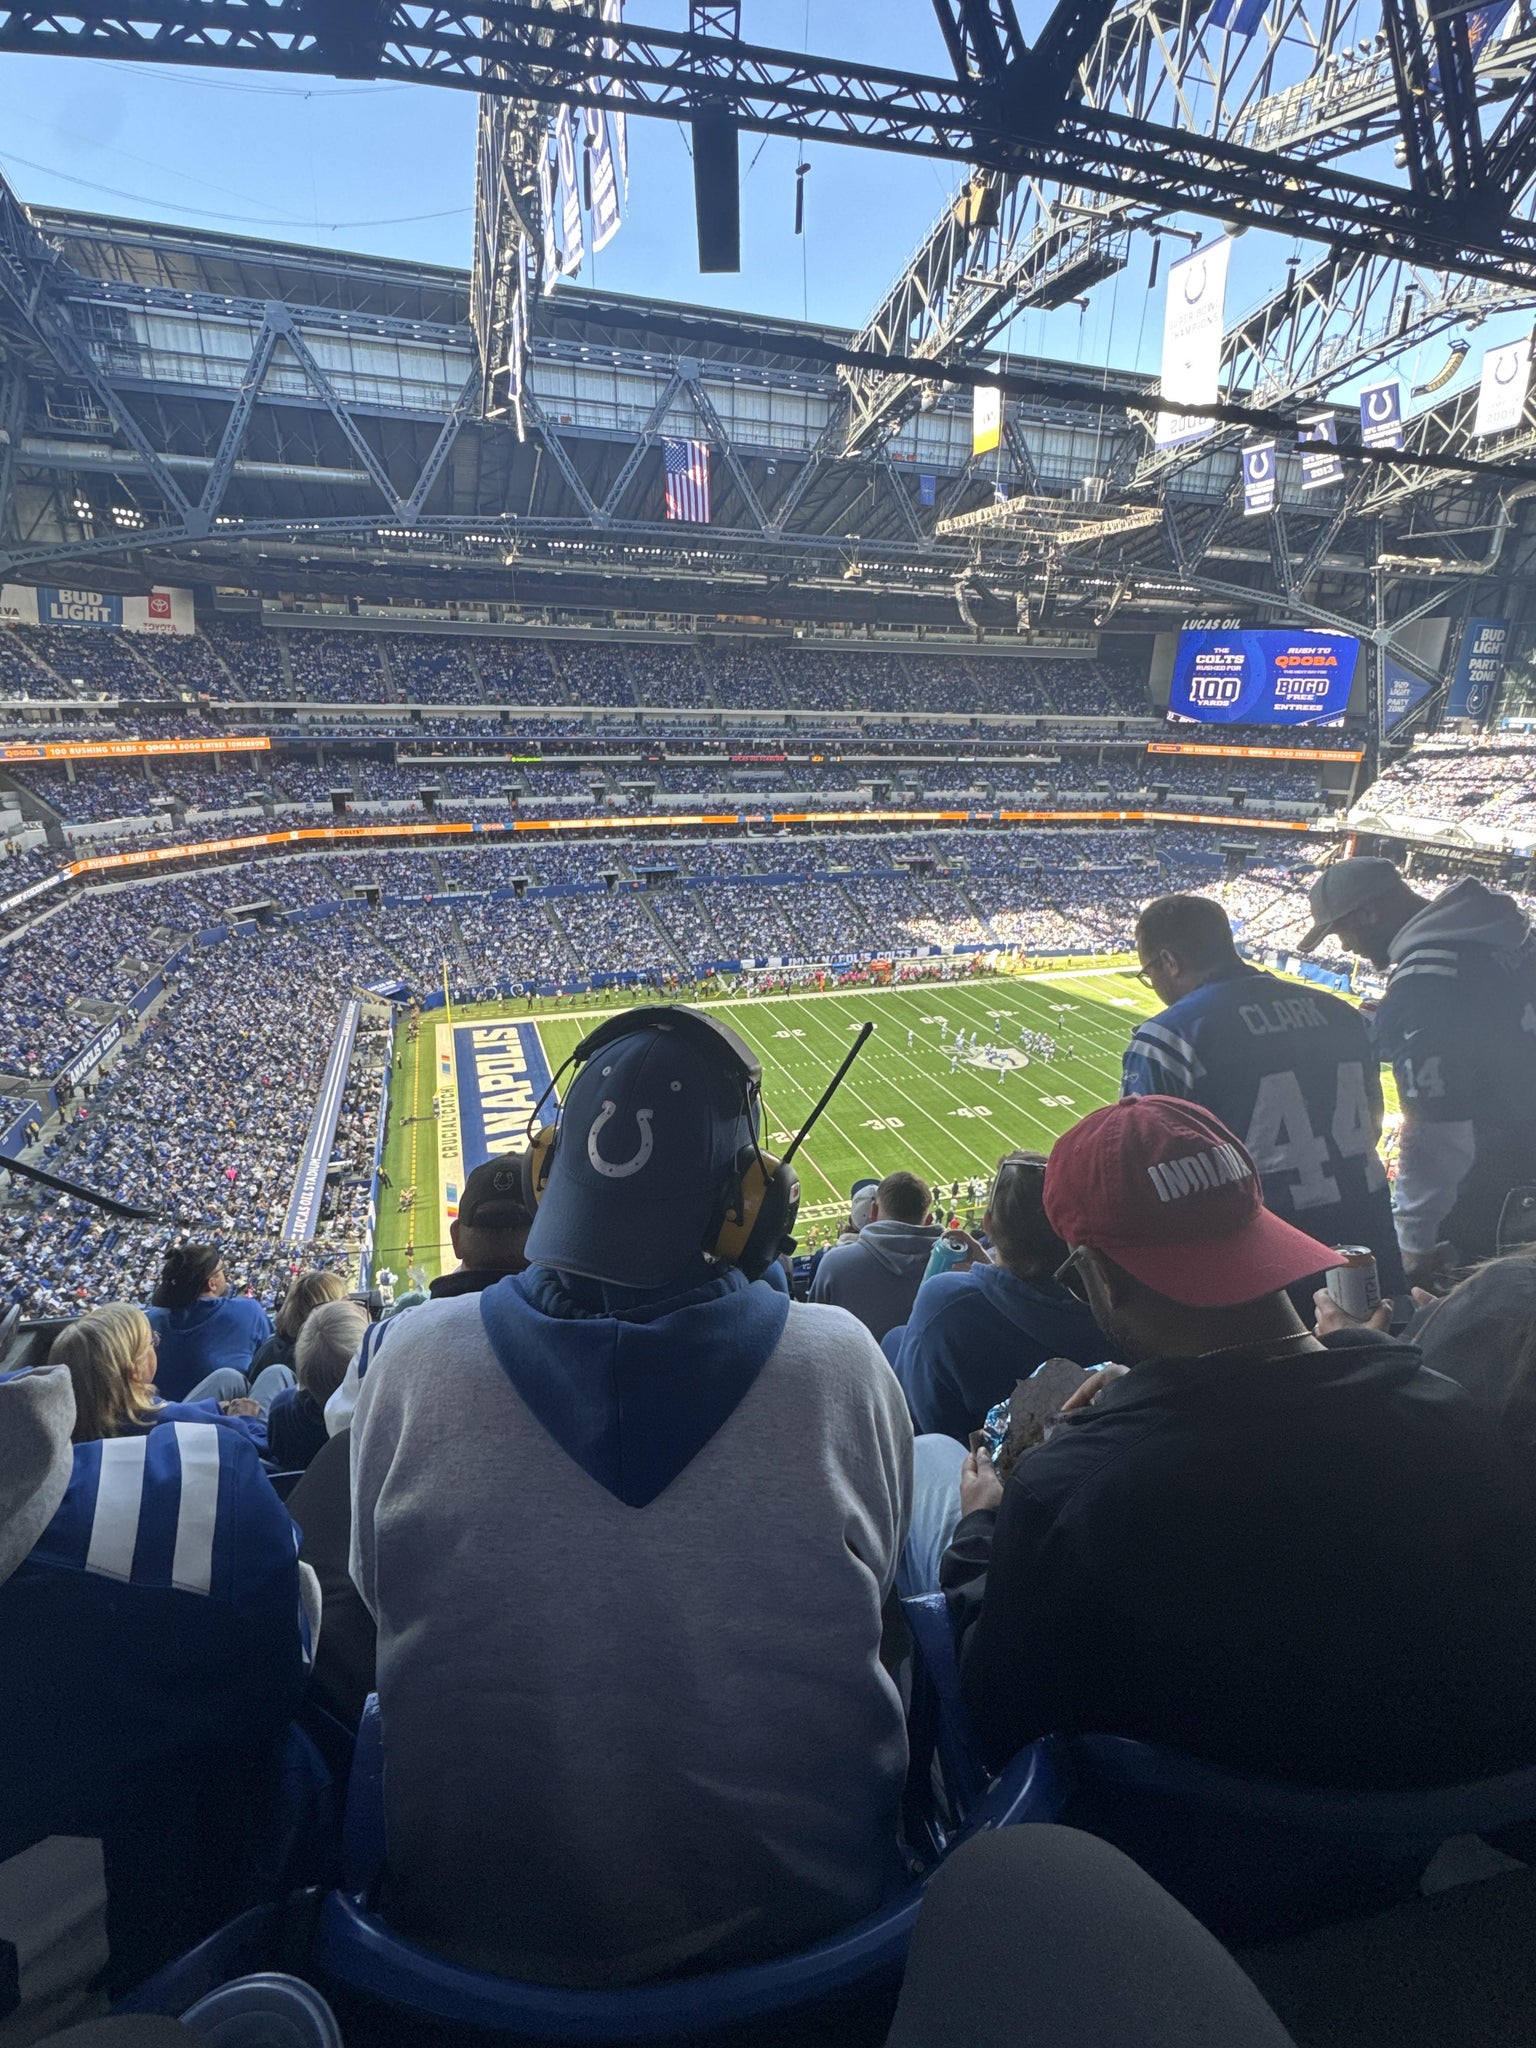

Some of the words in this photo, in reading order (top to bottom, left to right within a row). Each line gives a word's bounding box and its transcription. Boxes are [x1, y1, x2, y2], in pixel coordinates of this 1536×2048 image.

[59, 589, 103, 606] BUD
[51, 603, 111, 622] LIGHT
[143, 622, 177, 632] TOYOTA
[1182, 619, 1220, 630] LUCAS
[1221, 619, 1241, 630] OIL
[1481, 628, 1505, 642] BUD
[1473, 642, 1505, 654] LIGHT
[1196, 655, 1245, 664] COLTS
[1275, 655, 1338, 669] QDOBA
[1469, 671, 1496, 682] ZONE
[1189, 677, 1242, 702] 100
[1274, 677, 1330, 697] BOGO
[1286, 693, 1315, 701] FREE
[1273, 703, 1323, 711] ENTREES
[50, 747, 67, 756] 100
[69, 746, 108, 755] RUSHING
[110, 745, 137, 754] YARDS
[1424, 846, 1449, 857] LUCAS
[1449, 850, 1462, 859] OIL
[88, 857, 124, 868] RUSHING
[877, 950, 913, 961] COLTS
[1238, 996, 1328, 1036] CLARK
[70, 1041, 103, 1086] ANAPOLIS
[1404, 1056, 1446, 1098] 14
[473, 1027, 542, 1153] ANAPOLIS
[957, 1105, 993, 1118] 40
[867, 1116, 905, 1131] 30
[442, 1116, 459, 1159] CRUCIAL
[1245, 1060, 1388, 1210] 44
[303, 1158, 321, 1191] STADIUM
[1147, 1142, 1253, 1203] INDIANA
[299, 1192, 314, 1206] OIL
[293, 1207, 311, 1233] LUCAS
